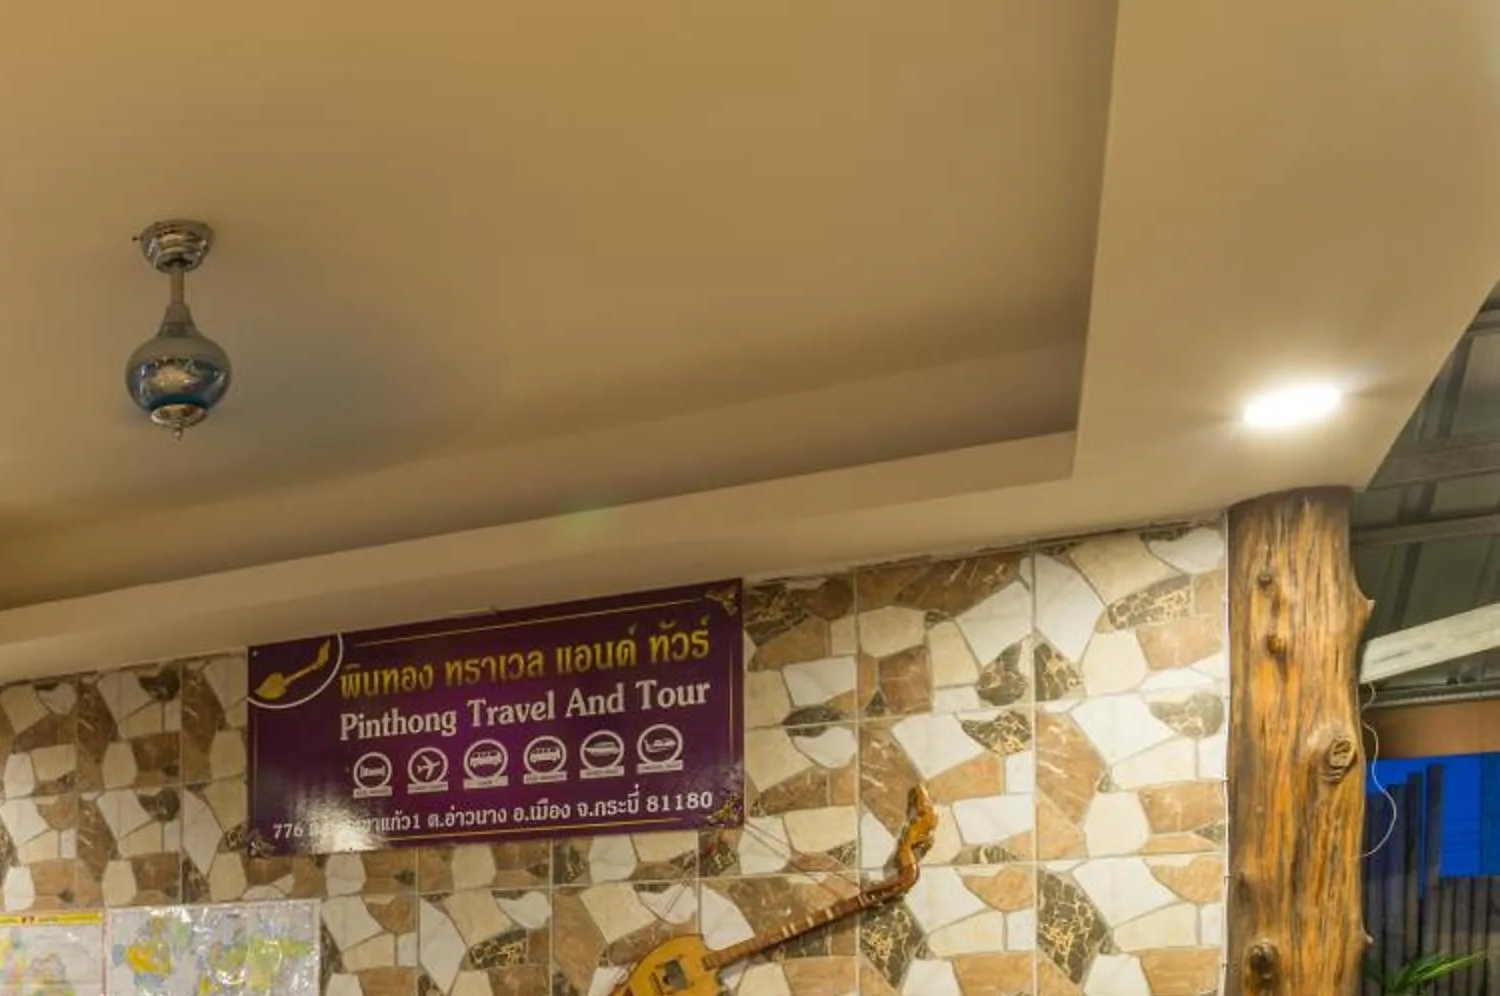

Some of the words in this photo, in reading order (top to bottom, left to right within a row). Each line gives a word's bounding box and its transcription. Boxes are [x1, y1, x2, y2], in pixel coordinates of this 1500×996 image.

[445, 650, 544, 687] ทราเวล
[556, 623, 638, 673] แอนด์
[649, 614, 711, 663] ทัวร์
[340, 707, 457, 741] Pinthong
[466, 689, 555, 727] Travel
[565, 682, 626, 718] And
[635, 679, 711, 711] Tour
[273, 823, 304, 839] 776
[577, 784, 639, 817] จ.กระบี่
[646, 791, 713, 813] 81180
